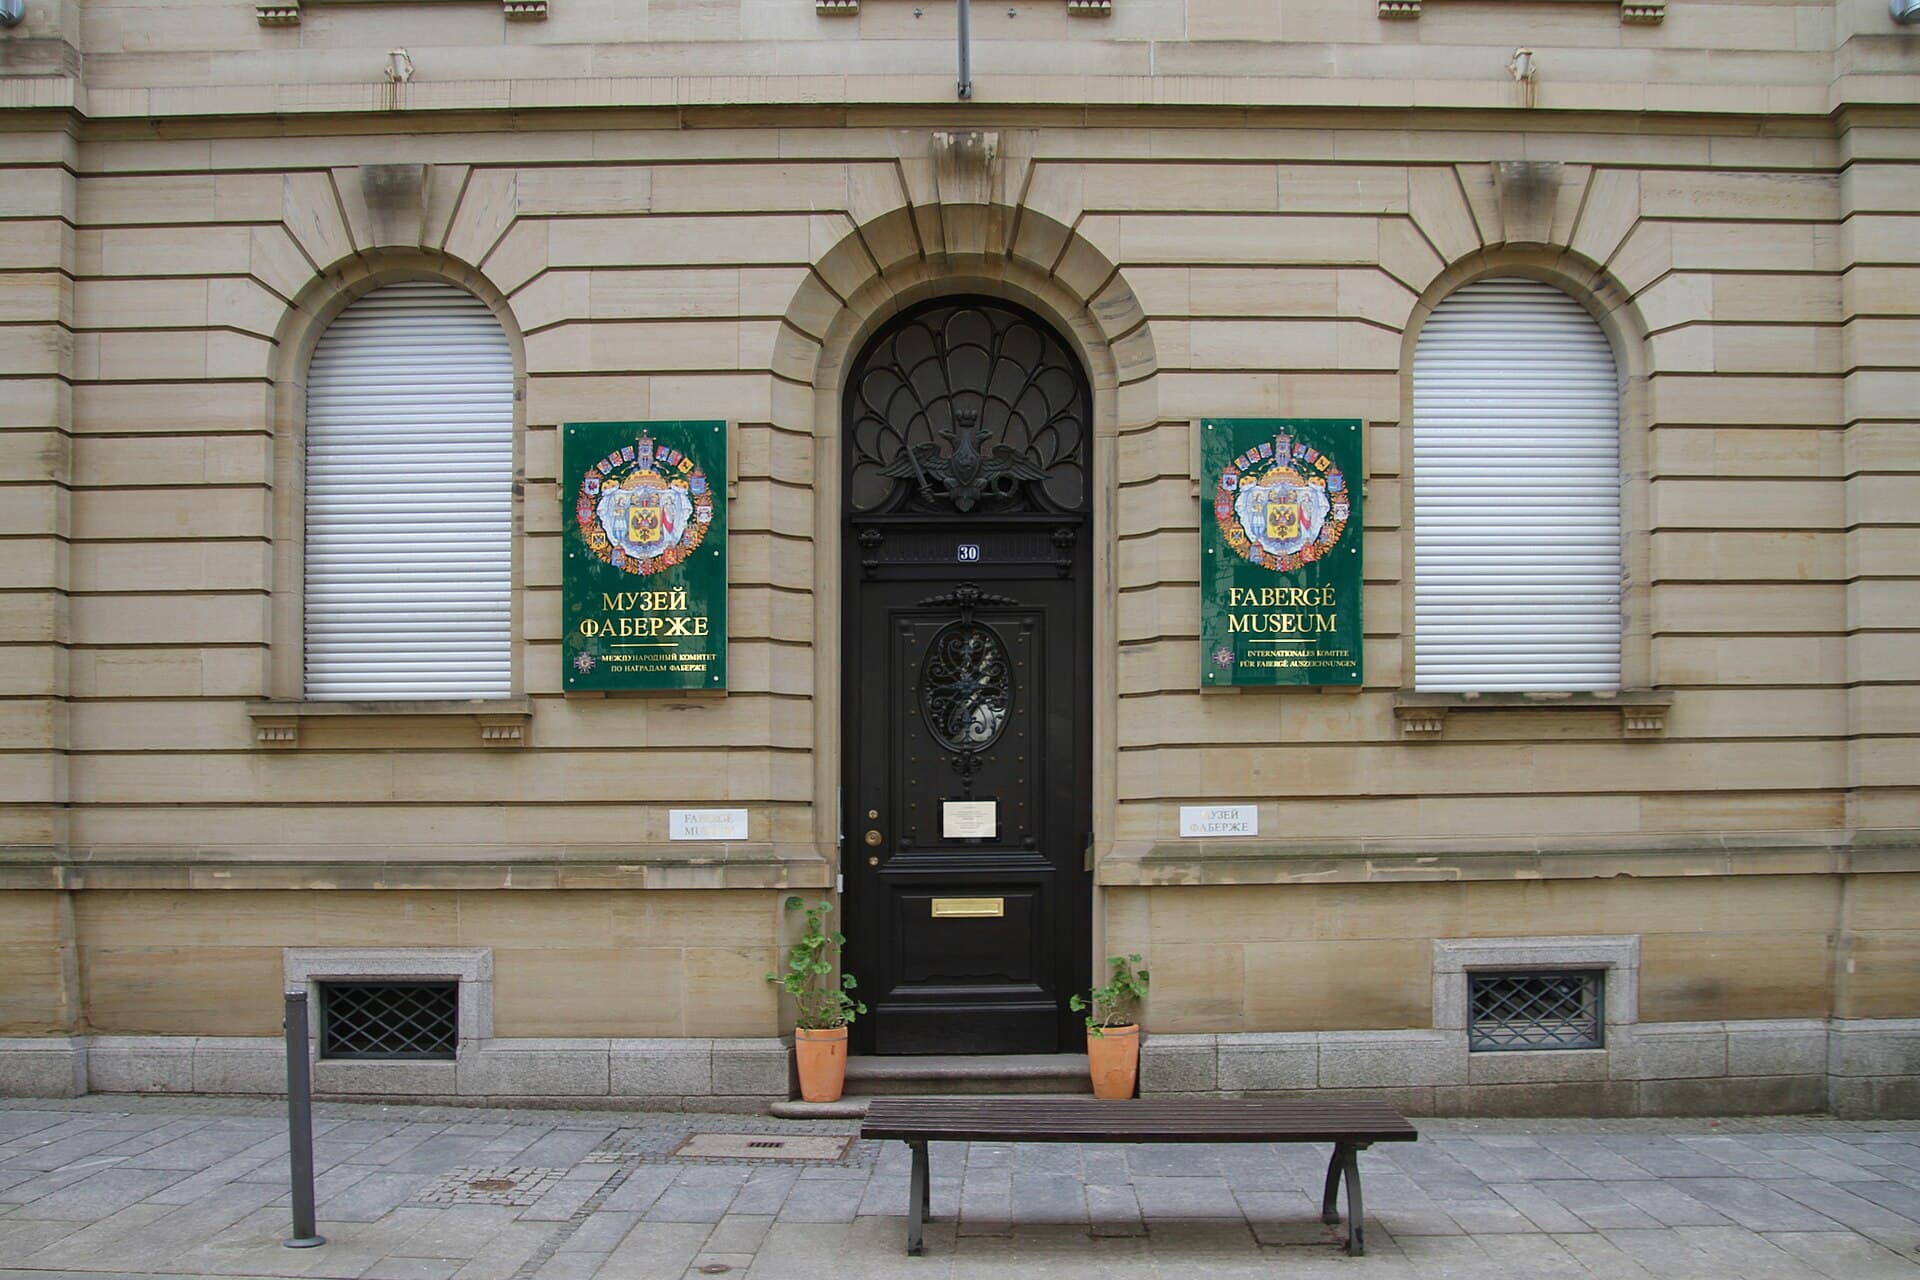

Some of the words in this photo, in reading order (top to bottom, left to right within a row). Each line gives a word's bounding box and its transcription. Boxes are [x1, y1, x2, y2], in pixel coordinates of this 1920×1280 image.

[961, 547, 976, 560] 30
[602, 586, 687, 611] МУЗЕЙ
[1229, 583, 1336, 607] FABERGÉ
[579, 616, 709, 637] ФАБЕРЖЕ
[1228, 613, 1337, 633] MUSEUM
[601, 653, 678, 662] МЕЖДУНАРОДНЫЙ
[679, 653, 717, 661] КОМИТЕТ
[624, 664, 667, 672] НАГРАДАМ
[669, 664, 707, 672] ФАБЕРЖЕ
